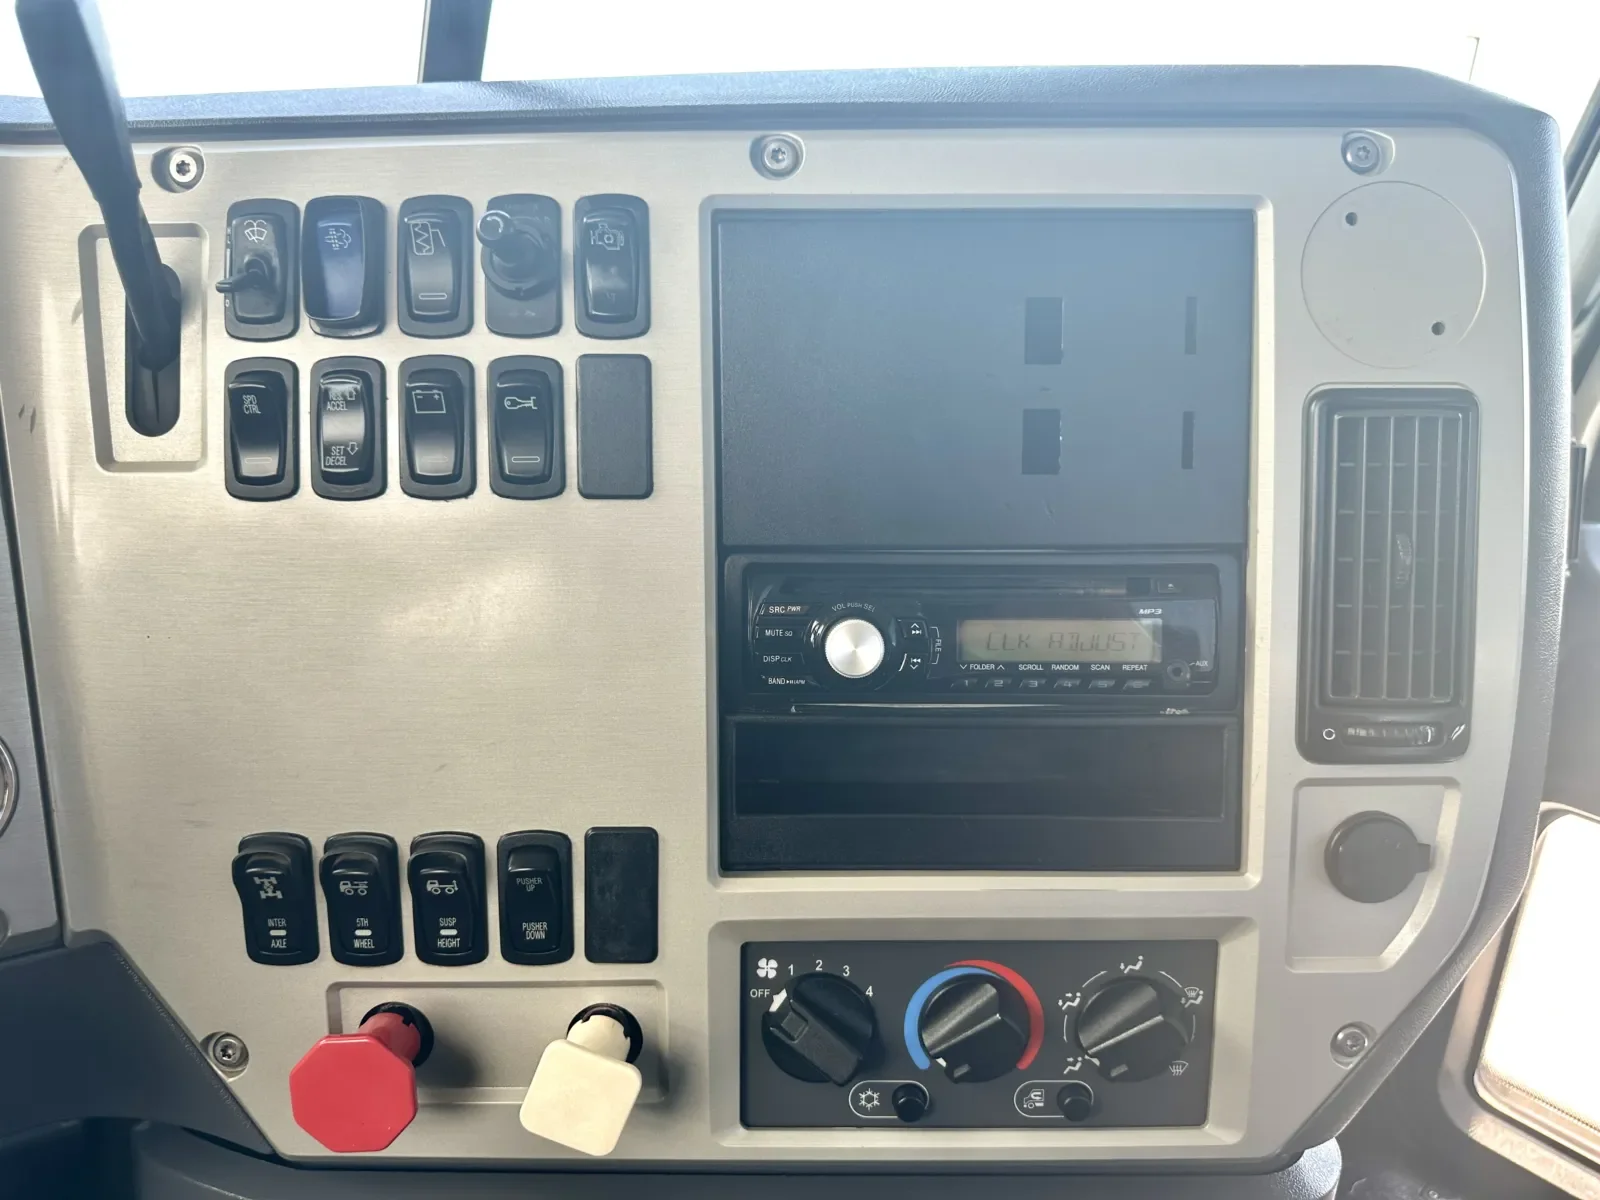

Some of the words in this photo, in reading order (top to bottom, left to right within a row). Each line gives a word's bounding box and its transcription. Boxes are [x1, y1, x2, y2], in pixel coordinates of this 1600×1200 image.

[242, 395, 257, 405] SPD
[243, 404, 261, 414] CTRL
[326, 401, 348, 411] ACCEL
[331, 446, 345, 456] SET
[325, 456, 347, 466] DECEL
[768, 606, 786, 614] SRC
[831, 603, 846, 612] VOL
[934, 638, 942, 652] FILE
[986, 632, 1031, 651] CLK
[1048, 632, 1141, 652] ADJUST
[763, 655, 780, 663] DISP
[969, 663, 996, 671] FOLDER
[1018, 663, 1044, 671] SCROLL
[1051, 663, 1080, 671] RANDOM
[1090, 663, 1111, 671] SCAN
[1121, 663, 1149, 671] REPEAT
[768, 677, 786, 685] BAND
[964, 679, 970, 687] 1
[993, 679, 1004, 688] 2
[1028, 680, 1038, 688] 3
[1063, 680, 1073, 688] 4
[516, 877, 543, 885] PUSHER
[525, 884, 536, 892] UP
[267, 918, 287, 927] INTER
[356, 917, 369, 927] 5TH
[439, 917, 457, 926] SUSP
[522, 921, 548, 931] PUSHER
[525, 930, 545, 940] DOWN
[270, 938, 287, 949] AXLE
[353, 938, 375, 949] WHEEL
[437, 937, 461, 948] HEIGHT
[787, 963, 794, 976] 1
[815, 959, 823, 971] 2
[842, 964, 850, 977] 3
[865, 985, 874, 997] 4
[749, 988, 771, 998] OFF
